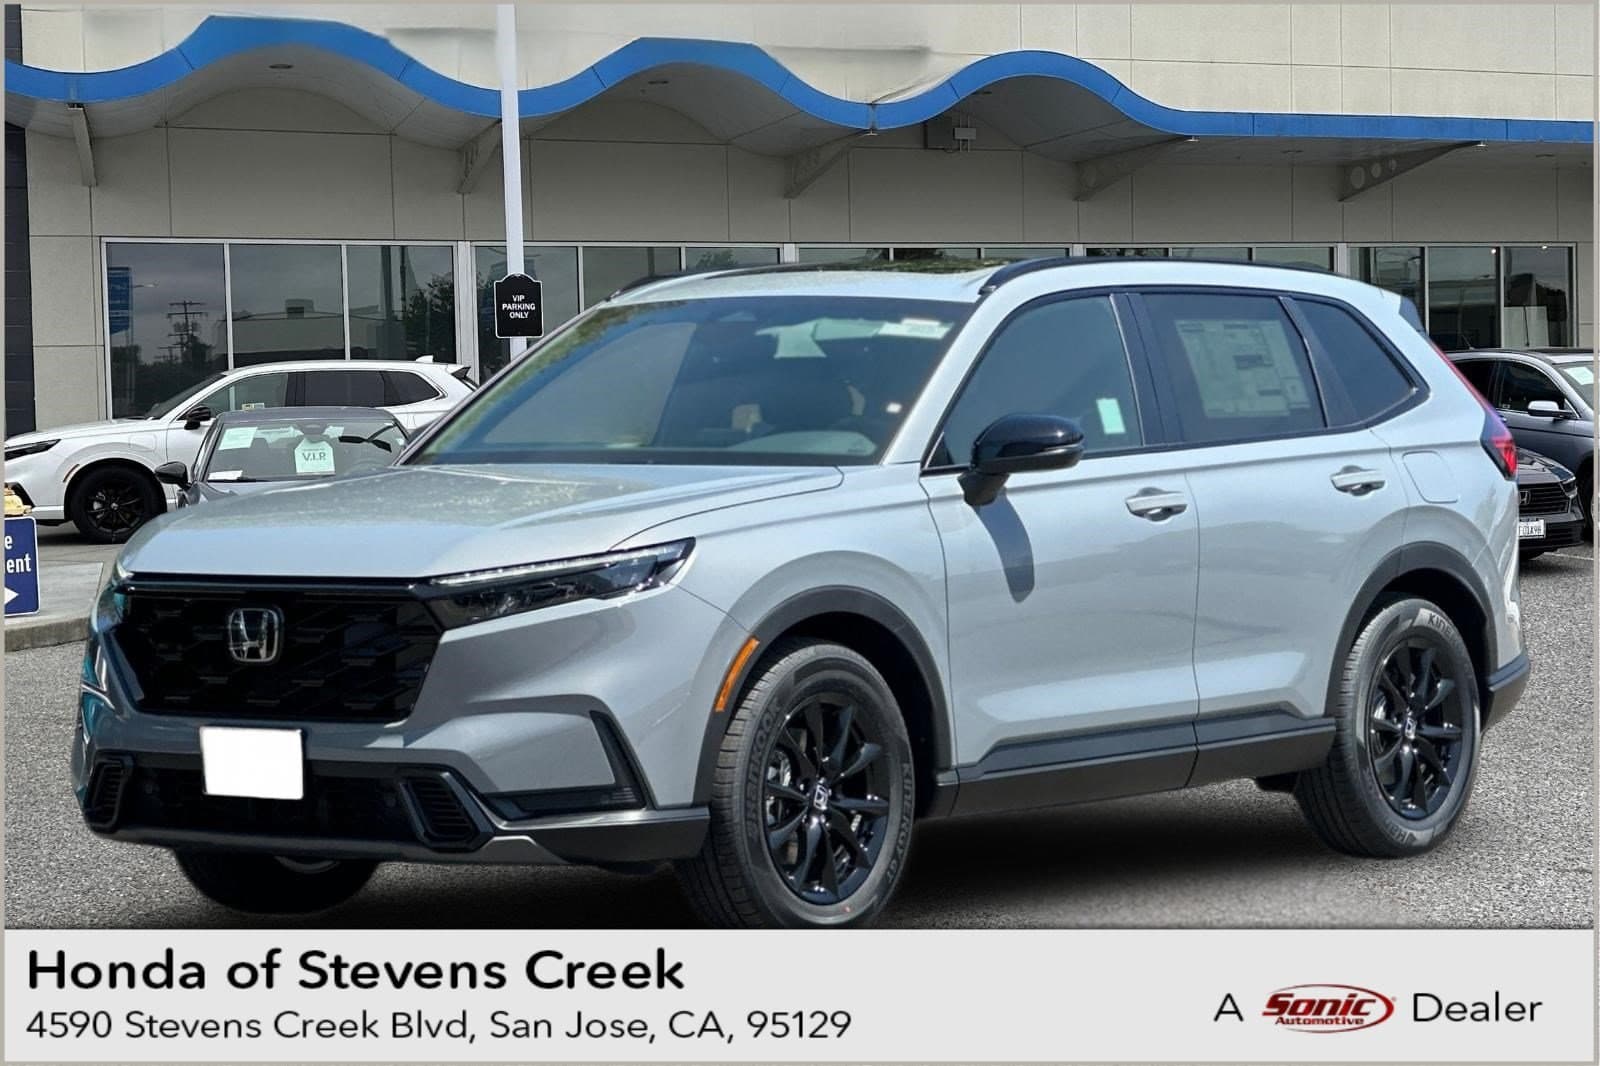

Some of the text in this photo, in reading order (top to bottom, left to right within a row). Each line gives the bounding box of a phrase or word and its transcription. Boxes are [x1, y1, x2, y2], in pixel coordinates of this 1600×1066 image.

[512, 294, 525, 302] VIP
[502, 303, 536, 311] PARKING
[509, 311, 530, 319] ONLY
